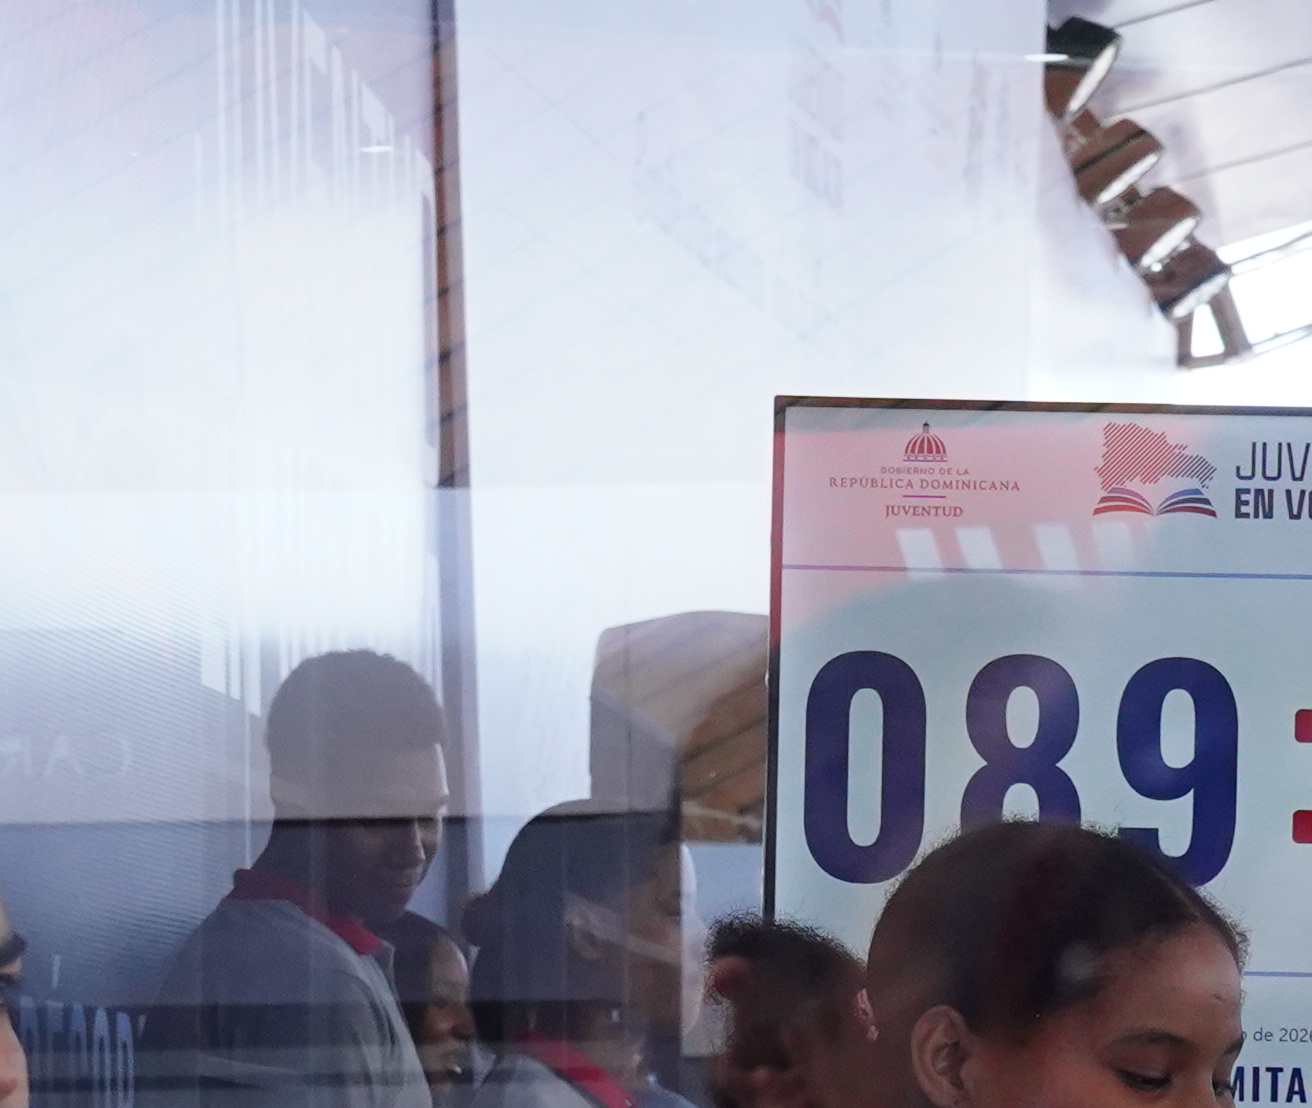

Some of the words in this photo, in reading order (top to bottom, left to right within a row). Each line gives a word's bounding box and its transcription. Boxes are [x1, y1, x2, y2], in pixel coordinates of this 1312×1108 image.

[880, 466, 936, 476] GOBIERNO
[939, 467, 953, 476] DE
[956, 467, 970, 476] LA
[829, 475, 915, 490] REPÚBLICA
[919, 479, 1021, 492] DOMINICANA
[884, 504, 964, 519] JUVENTUD
[1234, 488, 1275, 520] EN
[1252, 1027, 1274, 1042] de
